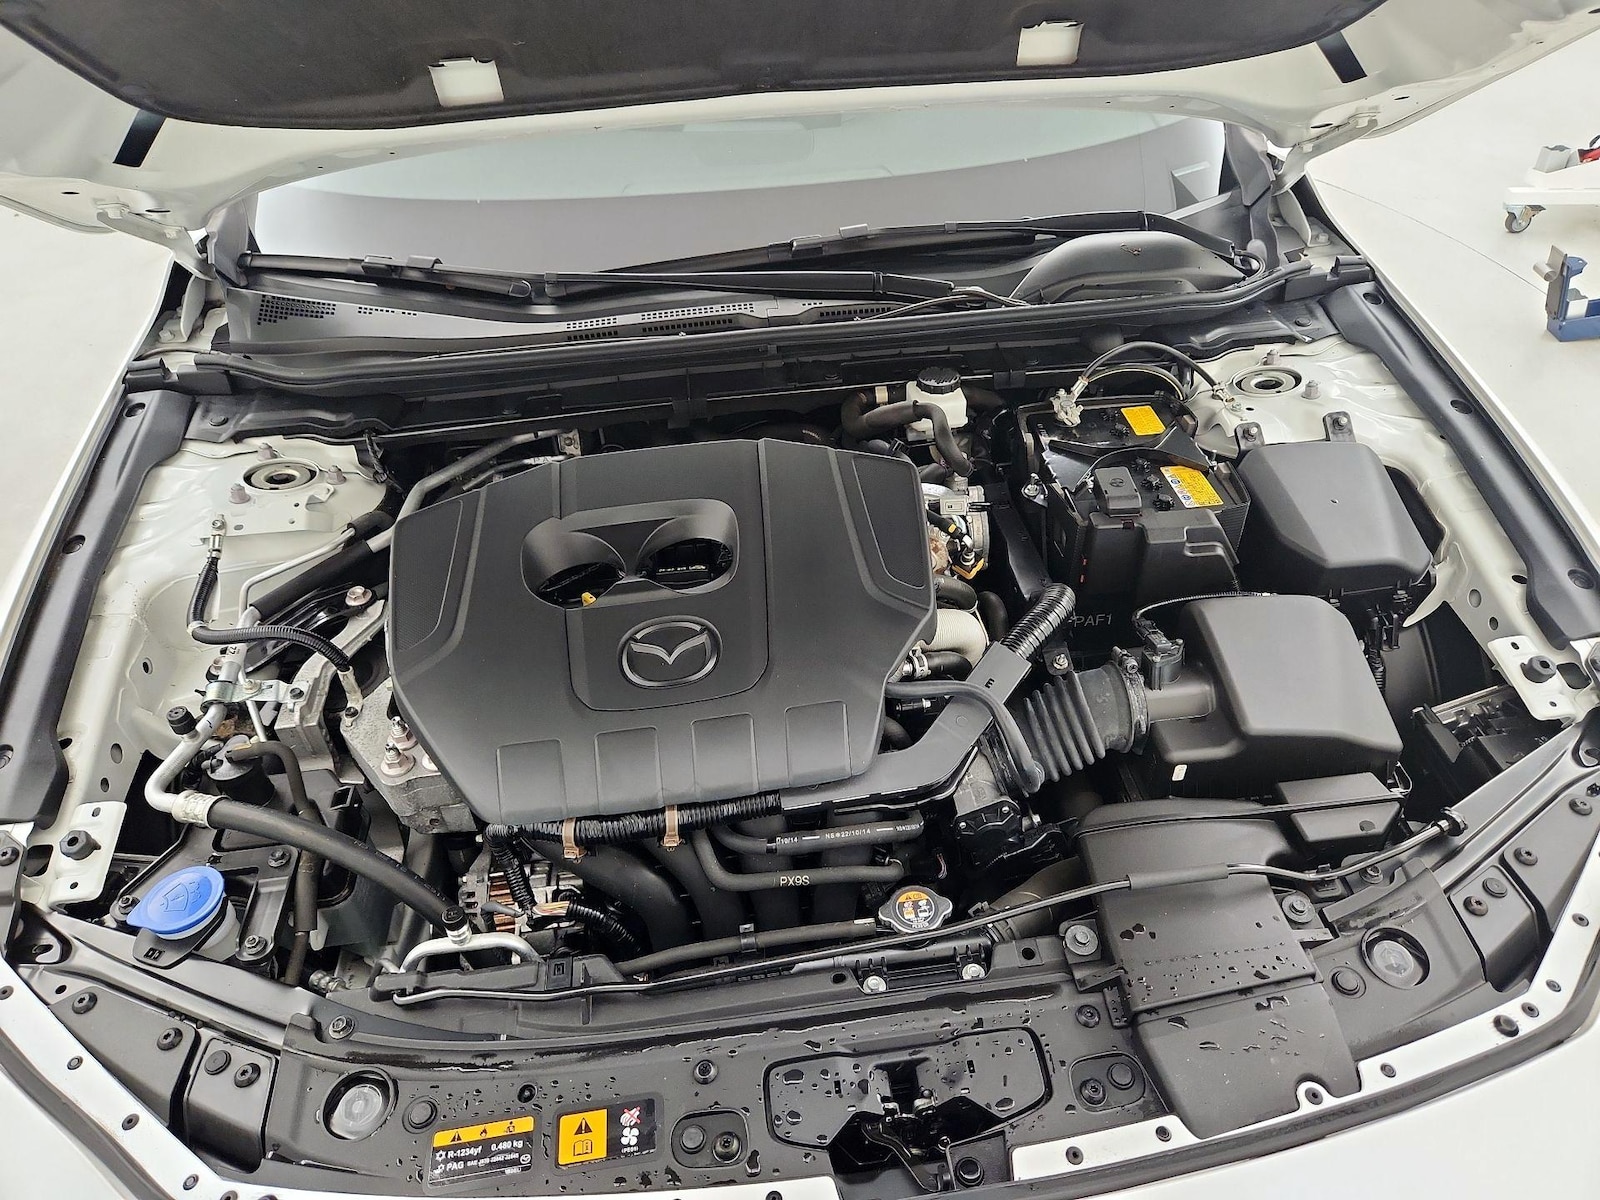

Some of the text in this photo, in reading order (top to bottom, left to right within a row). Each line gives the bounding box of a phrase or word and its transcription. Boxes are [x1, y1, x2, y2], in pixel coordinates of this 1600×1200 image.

[1074, 613, 1112, 628] PAF1
[780, 875, 810, 887] PX9S
[447, 1145, 482, 1159] R-1234yf
[490, 1139, 524, 1152] 0.480 kg
[446, 1161, 465, 1171] PAG
